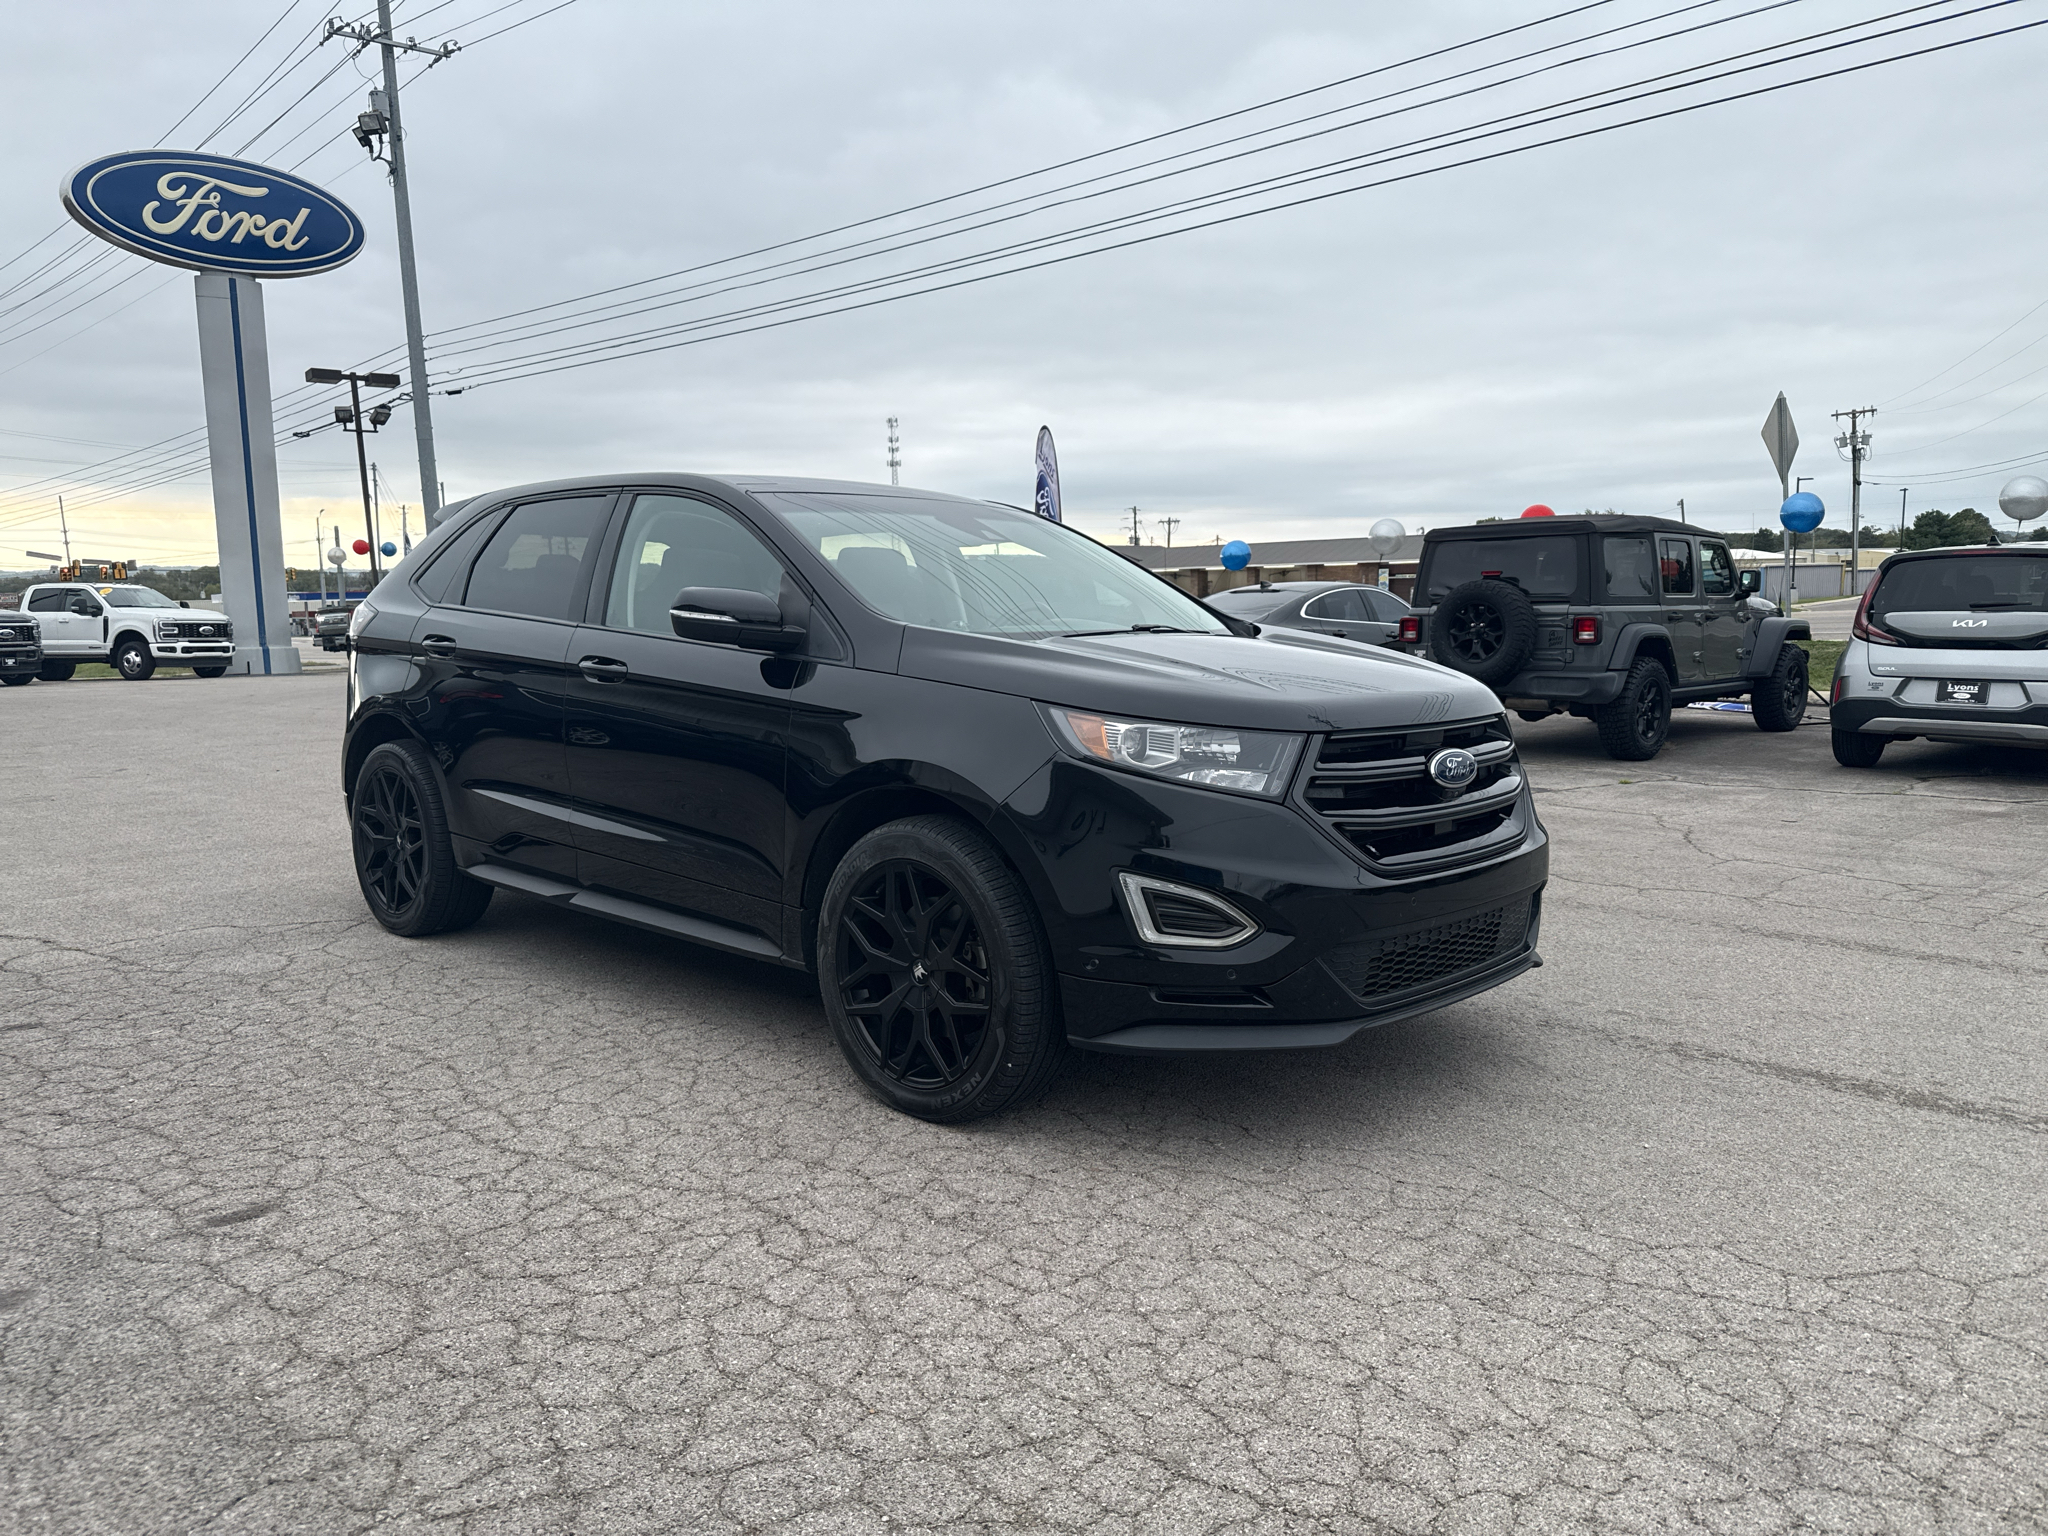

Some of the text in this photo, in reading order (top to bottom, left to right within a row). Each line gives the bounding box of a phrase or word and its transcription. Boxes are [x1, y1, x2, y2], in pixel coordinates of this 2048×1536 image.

[142, 171, 312, 251] Ford
[1947, 683, 1979, 692] Lyons
[1446, 757, 1472, 777] Ford
[930, 1071, 982, 1110] NEXEN
